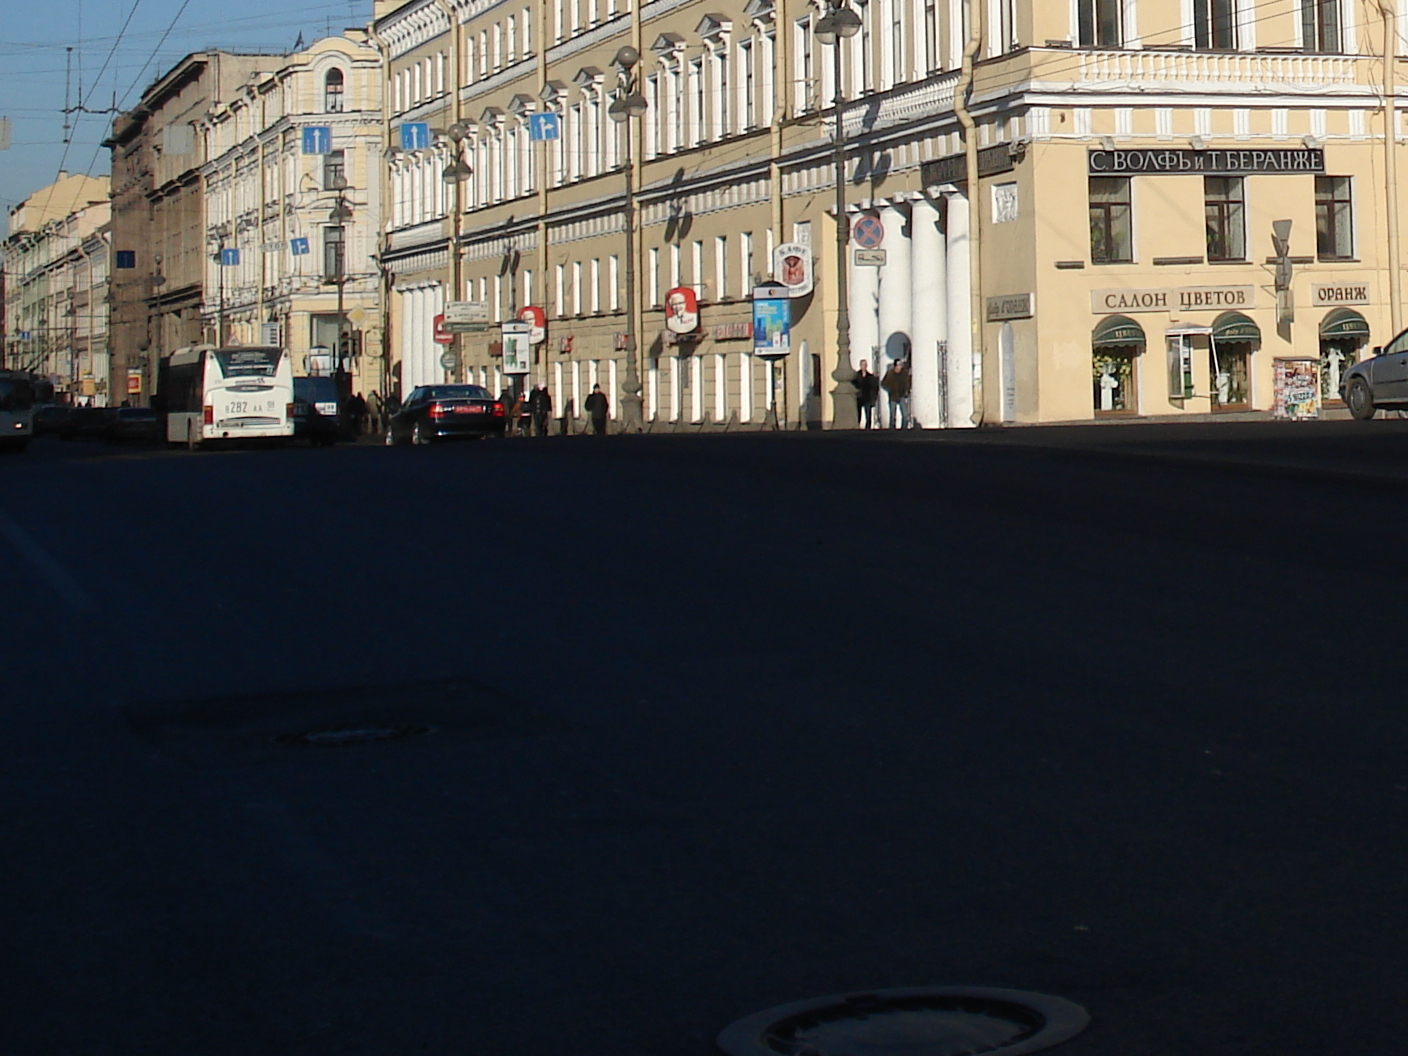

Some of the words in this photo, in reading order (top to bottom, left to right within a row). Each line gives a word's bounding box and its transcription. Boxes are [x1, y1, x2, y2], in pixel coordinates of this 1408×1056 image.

[1113, 150, 1191, 171] ВОЛФЪ
[1226, 150, 1323, 171] БЕРАНЖЕ
[1105, 293, 1167, 309] САЛОН
[1180, 290, 1246, 310] ЦВЕТОВ
[1318, 286, 1367, 301] ОРАНЖ
[230, 401, 248, 414] 282
